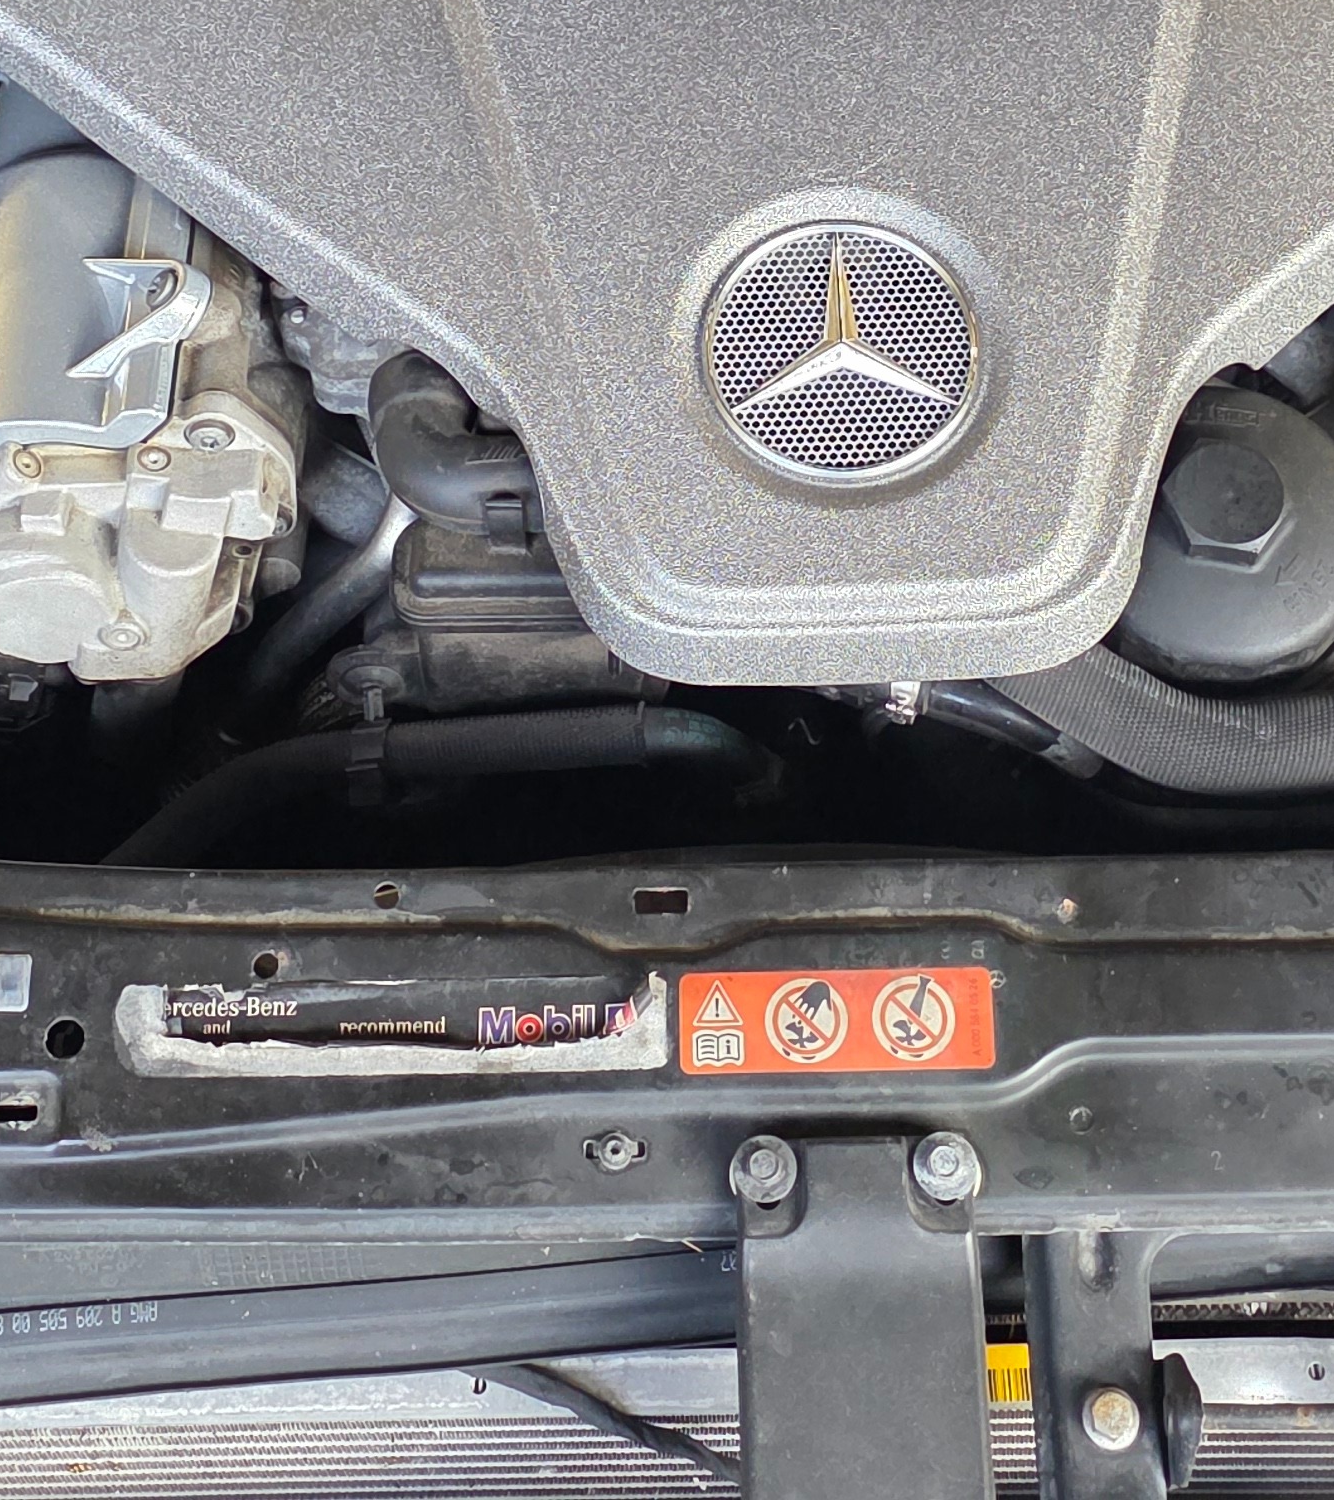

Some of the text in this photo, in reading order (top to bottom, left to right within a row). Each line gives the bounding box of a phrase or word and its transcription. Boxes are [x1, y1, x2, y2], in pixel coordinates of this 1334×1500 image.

[163, 996, 298, 1018] ercedes-Benz
[203, 1016, 447, 1037] and recommend
[478, 1004, 596, 1045] Mobil
[12, 1312, 31, 1334] 00
[39, 1308, 67, 1332] 505
[76, 1306, 103, 1329] 209
[112, 1304, 122, 1325] A
[130, 1301, 158, 1323] AMG
